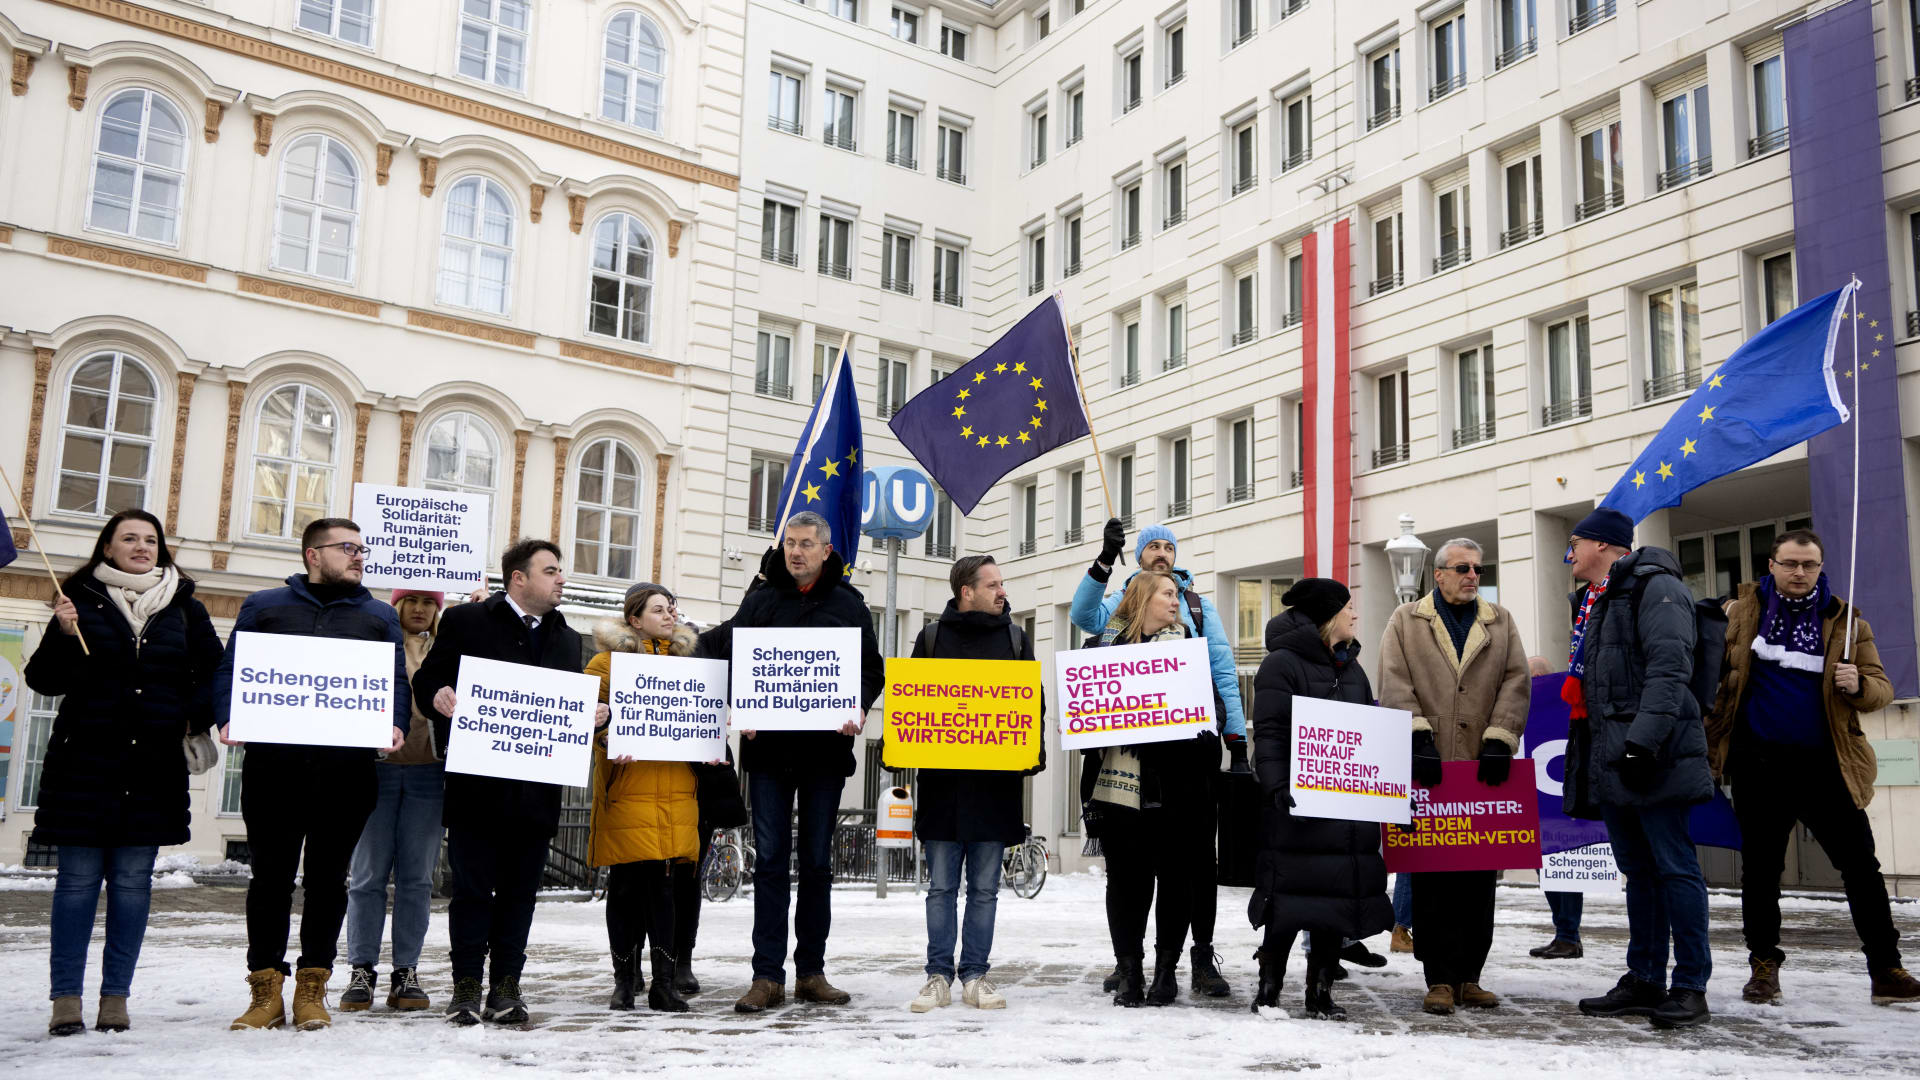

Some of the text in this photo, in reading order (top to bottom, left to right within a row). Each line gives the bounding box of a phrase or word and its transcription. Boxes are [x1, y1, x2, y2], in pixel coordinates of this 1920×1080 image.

[376, 493, 468, 513] Europäische
[893, 479, 926, 522] U
[382, 508, 461, 525] Solidarität:
[383, 522, 458, 538] Rumänien
[365, 535, 473, 554] und Bulgarien,
[392, 550, 446, 565] jetzt im
[364, 562, 481, 582] chengen-Raum!
[752, 647, 841, 664] Schengen,
[240, 667, 389, 691] Schengen ist
[752, 663, 841, 677] stärker mit
[1065, 657, 1187, 682] SCHENGEN-
[635, 674, 706, 692] Öffnet die
[754, 679, 838, 693] Rumänien
[891, 683, 1034, 699] SCHENGEN-VETO
[1066, 680, 1122, 698] VETO
[242, 691, 386, 713] unser Recht!
[471, 684, 585, 713] Rumänien hat
[614, 690, 724, 710] Schengen-Tore
[736, 695, 856, 712] und Bulgarien!
[1068, 692, 1167, 716] SCHADET
[477, 704, 573, 729] es verdient,
[620, 706, 717, 723] für Rumänien
[891, 710, 1033, 729] SCHLECHT FÜR
[1069, 706, 1206, 733] ÖSTERREICH!
[457, 716, 589, 746] Schengen-Land
[616, 723, 721, 741] und Bulgarien!
[897, 727, 1027, 746] WIRTSCHAFT!
[1298, 725, 1362, 746] DARF DER
[491, 740, 553, 757] zu sein!
[1298, 741, 1356, 760] EINKAUF
[1297, 757, 1379, 779] TEUER SEIN?
[1297, 774, 1406, 798] SCHENGEN-NEIN!
[1410, 789, 1430, 802] RR
[1411, 800, 1523, 817] ENMINISTER:
[1387, 817, 1472, 833] EDE DEM
[1387, 829, 1536, 848] SCHENGEN-VETO!
[1548, 856, 1607, 870] Schengen
[1544, 869, 1617, 881] Land zu sein!
